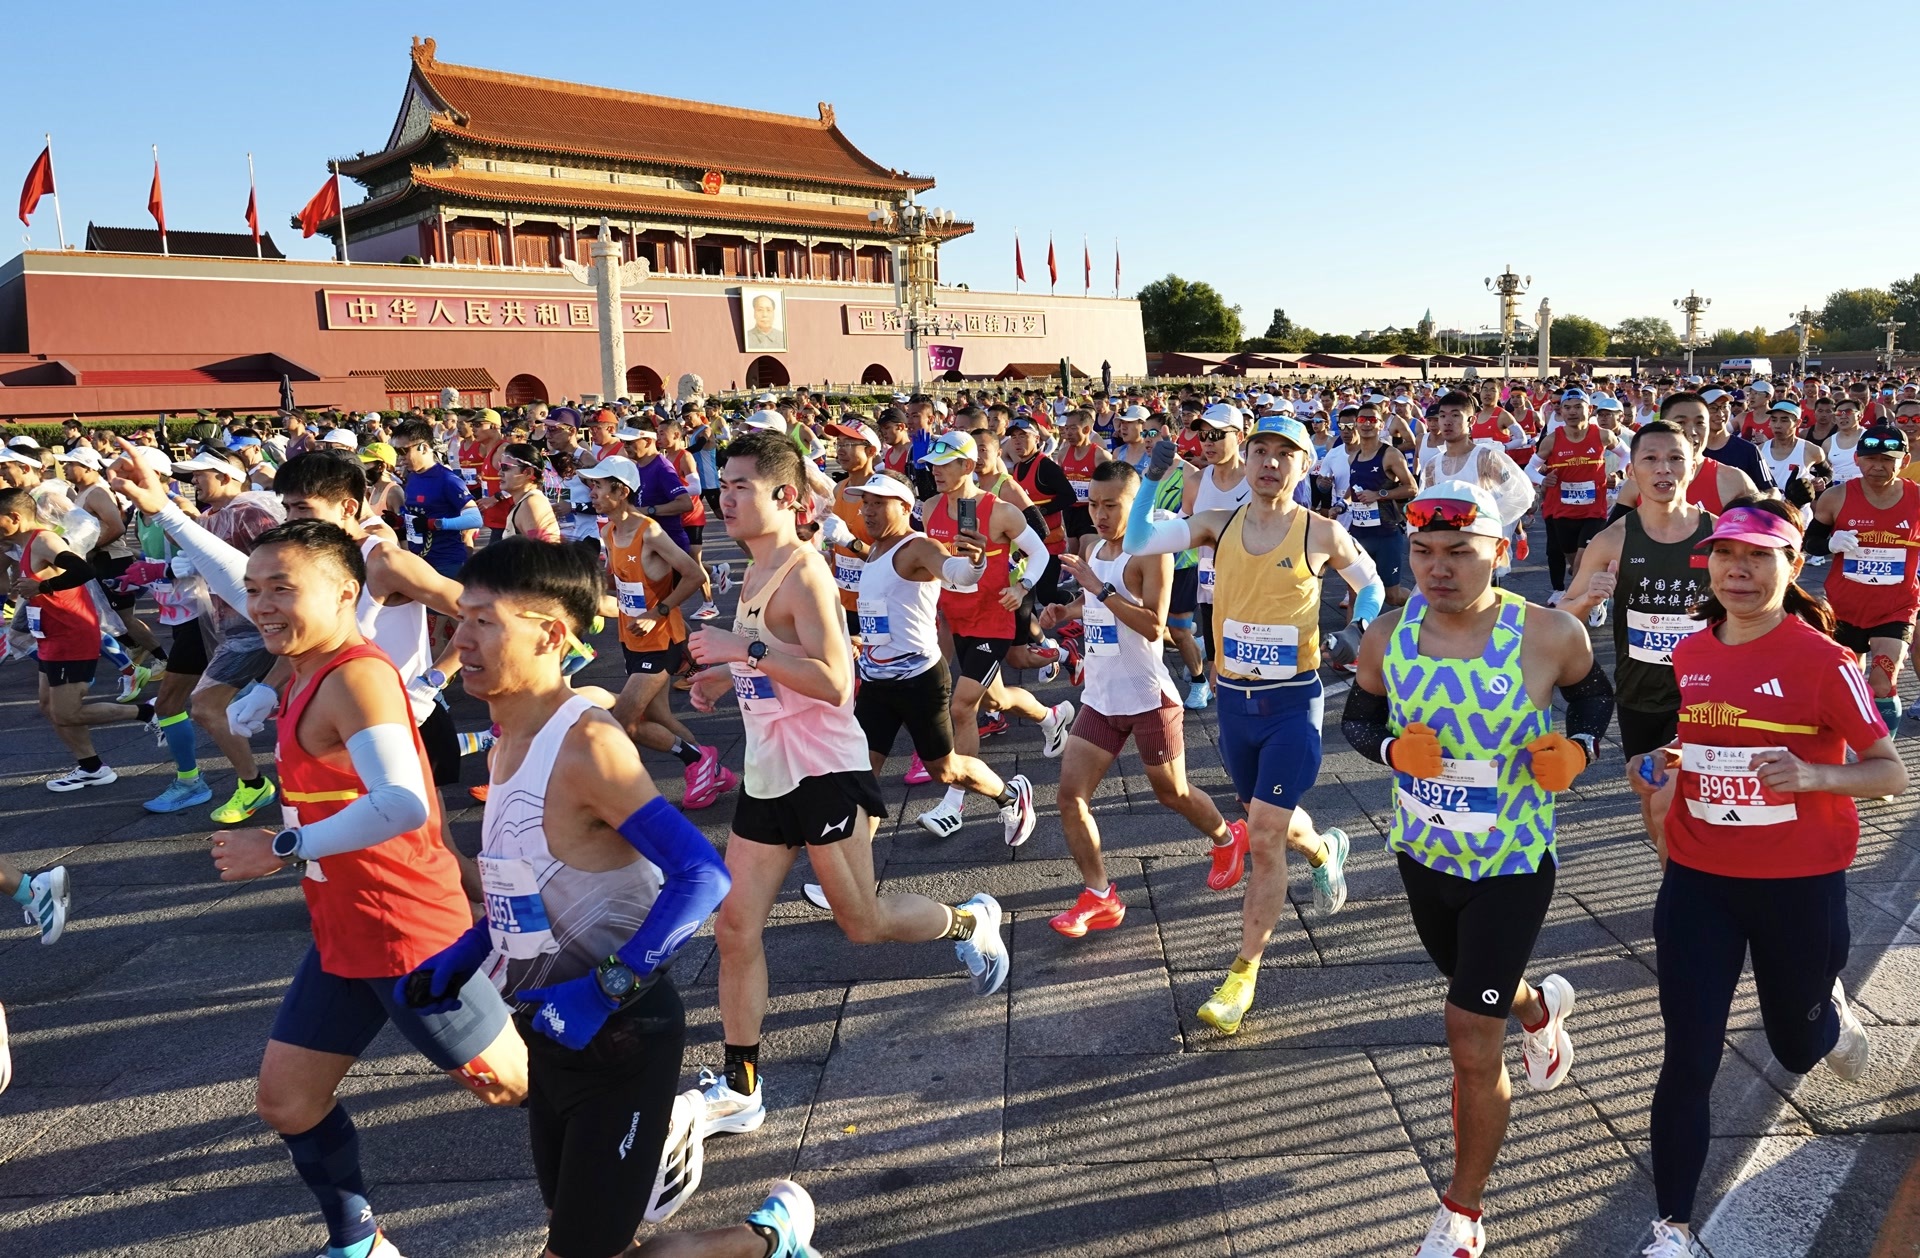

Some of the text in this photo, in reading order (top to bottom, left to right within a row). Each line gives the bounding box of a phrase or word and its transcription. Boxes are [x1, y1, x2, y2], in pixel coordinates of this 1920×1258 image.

[348, 297, 656, 328] 中华人民共和国岁
[859, 310, 1038, 333] 世界大团结万岁
[1862, 532, 1896, 544] BEIJING
[1857, 561, 1892, 573] B4226
[1640, 577, 1698, 592] 中国老兵
[1237, 642, 1279, 661] B3726
[1690, 704, 1740, 727] BEIJING
[1412, 777, 1469, 807] A3972
[1699, 774, 1764, 800] B9612
[624, 1111, 640, 1150] saucony
